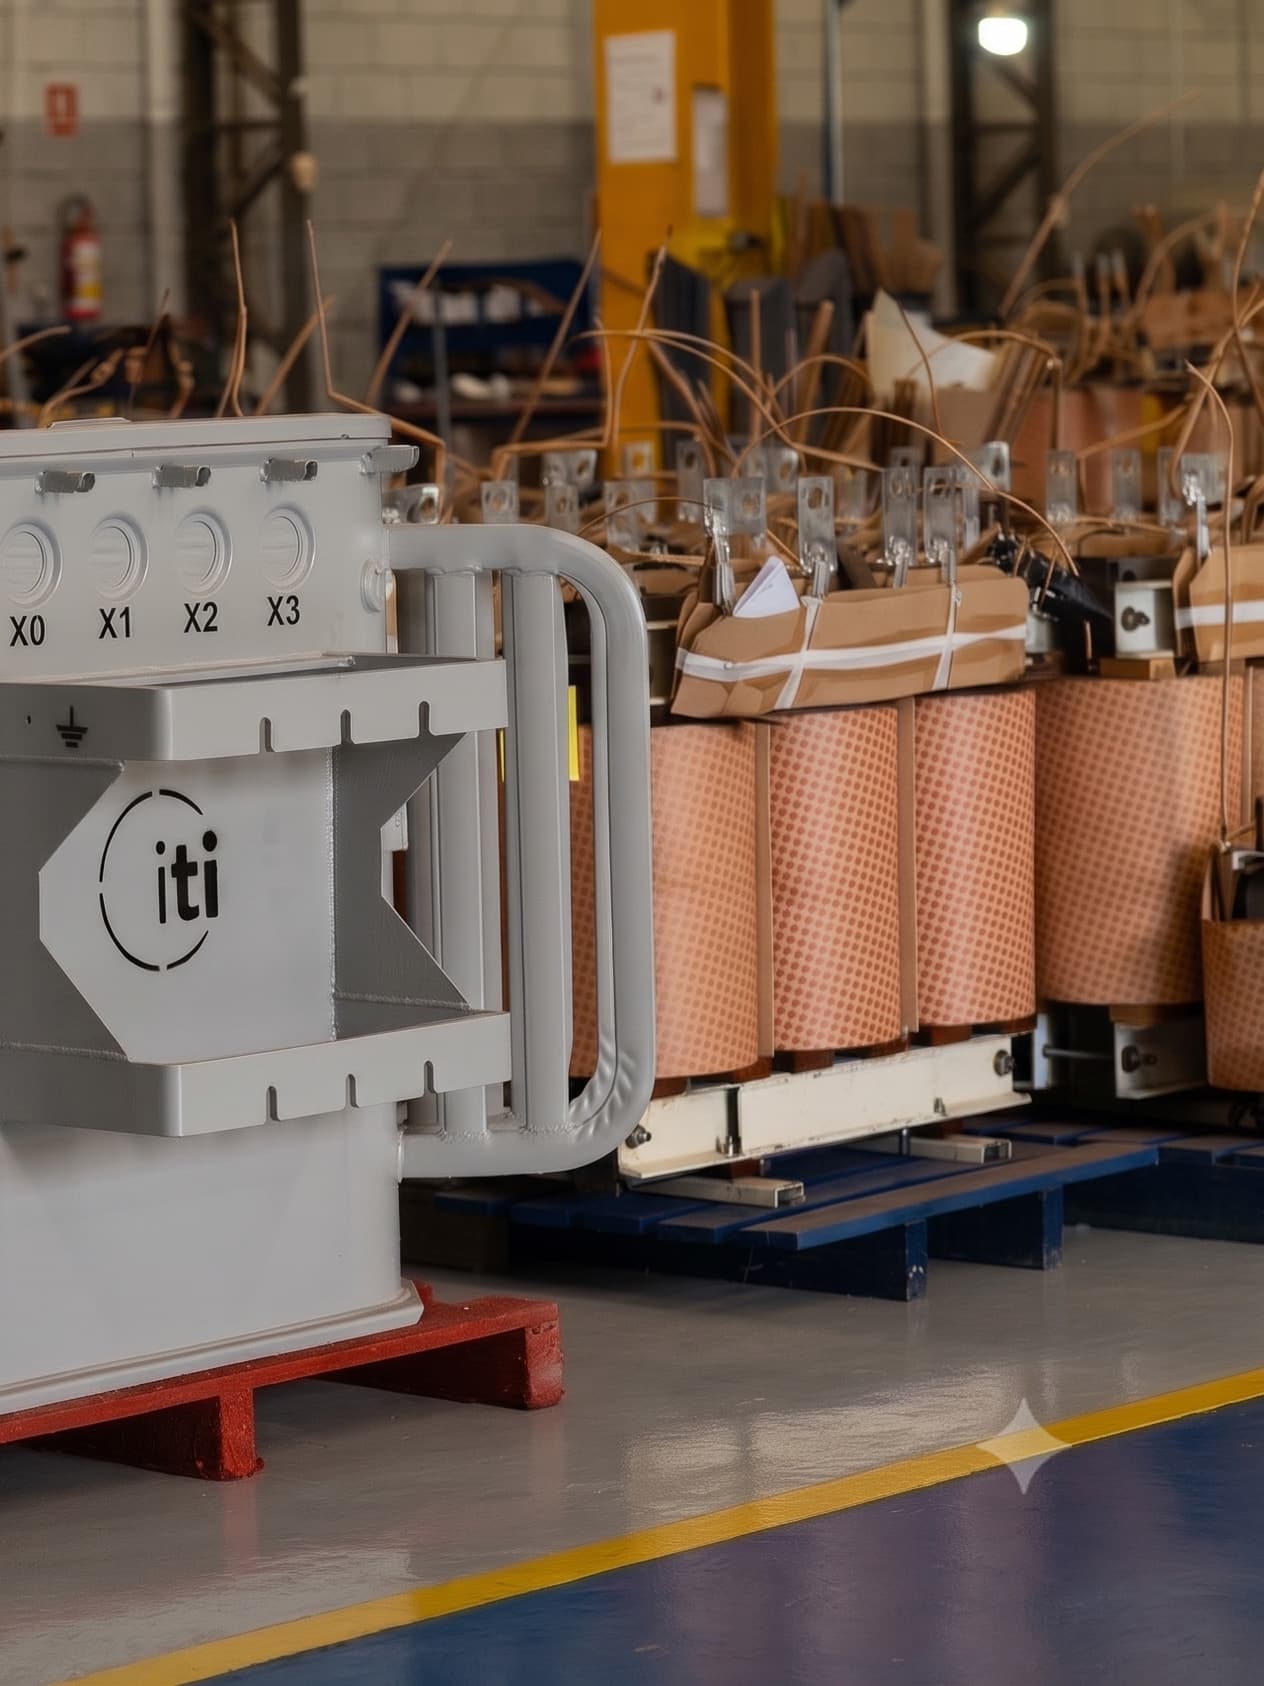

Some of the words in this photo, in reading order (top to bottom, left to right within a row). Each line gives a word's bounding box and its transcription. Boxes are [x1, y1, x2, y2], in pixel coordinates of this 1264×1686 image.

[9, 614, 46, 647] X0
[98, 606, 131, 640] X1
[183, 601, 218, 634] X2
[267, 594, 301, 627] X3
[155, 829, 219, 924] iti
